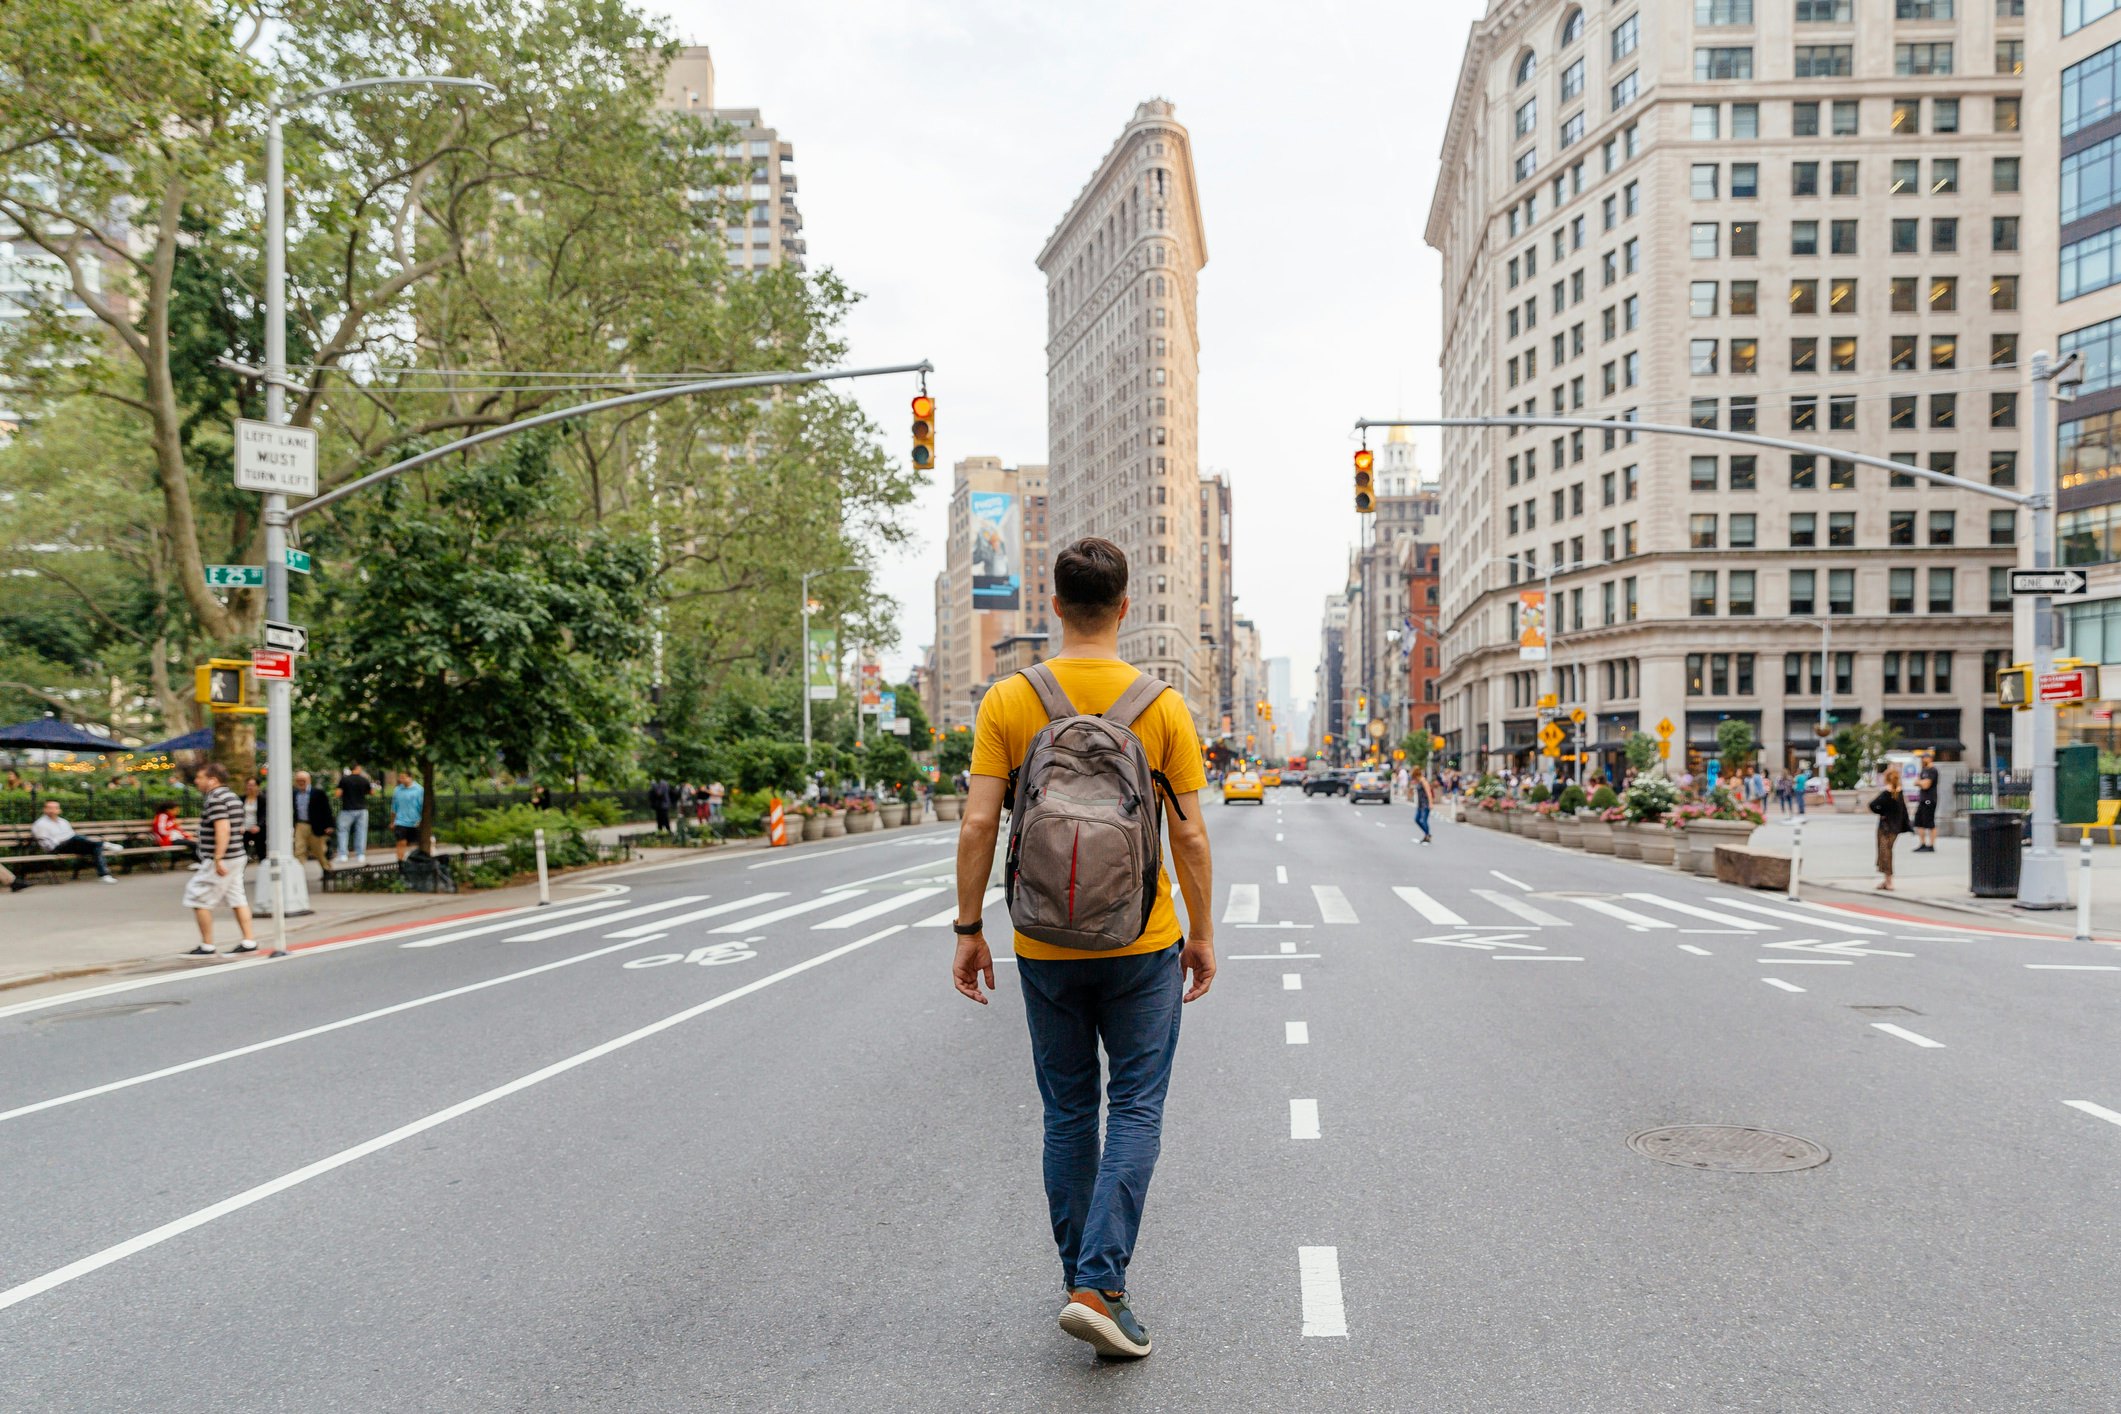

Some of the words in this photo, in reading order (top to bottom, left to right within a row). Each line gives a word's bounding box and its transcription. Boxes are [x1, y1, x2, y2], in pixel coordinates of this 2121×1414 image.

[244, 430, 272, 443] LEFT
[279, 435, 308, 449] LANE
[257, 451, 296, 467] MUST
[245, 468, 276, 482] TURN
[280, 474, 309, 486] LEFT
[209, 567, 220, 584] E
[2020, 577, 2042, 589] ONE
[2053, 577, 2075, 587] WAY
